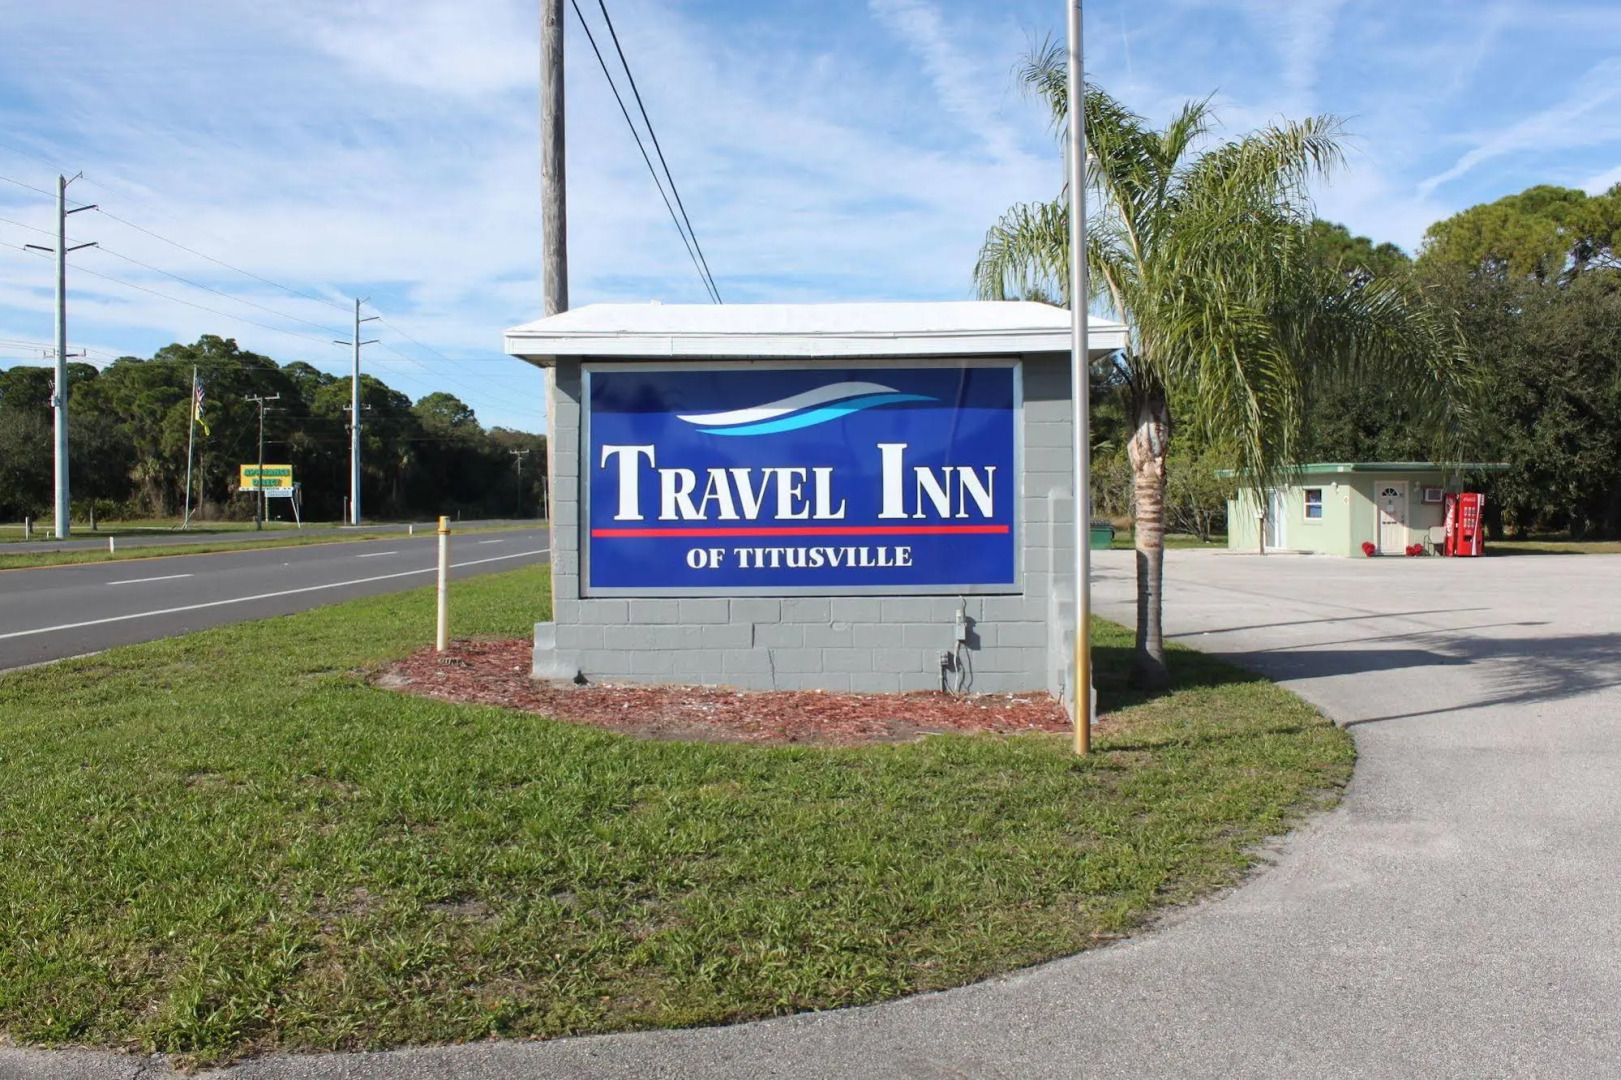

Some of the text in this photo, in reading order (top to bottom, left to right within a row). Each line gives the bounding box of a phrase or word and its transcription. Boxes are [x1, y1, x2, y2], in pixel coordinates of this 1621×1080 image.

[600, 442, 997, 521] TRAVEL INN
[686, 546, 914, 570] OF TITUSVILLE
